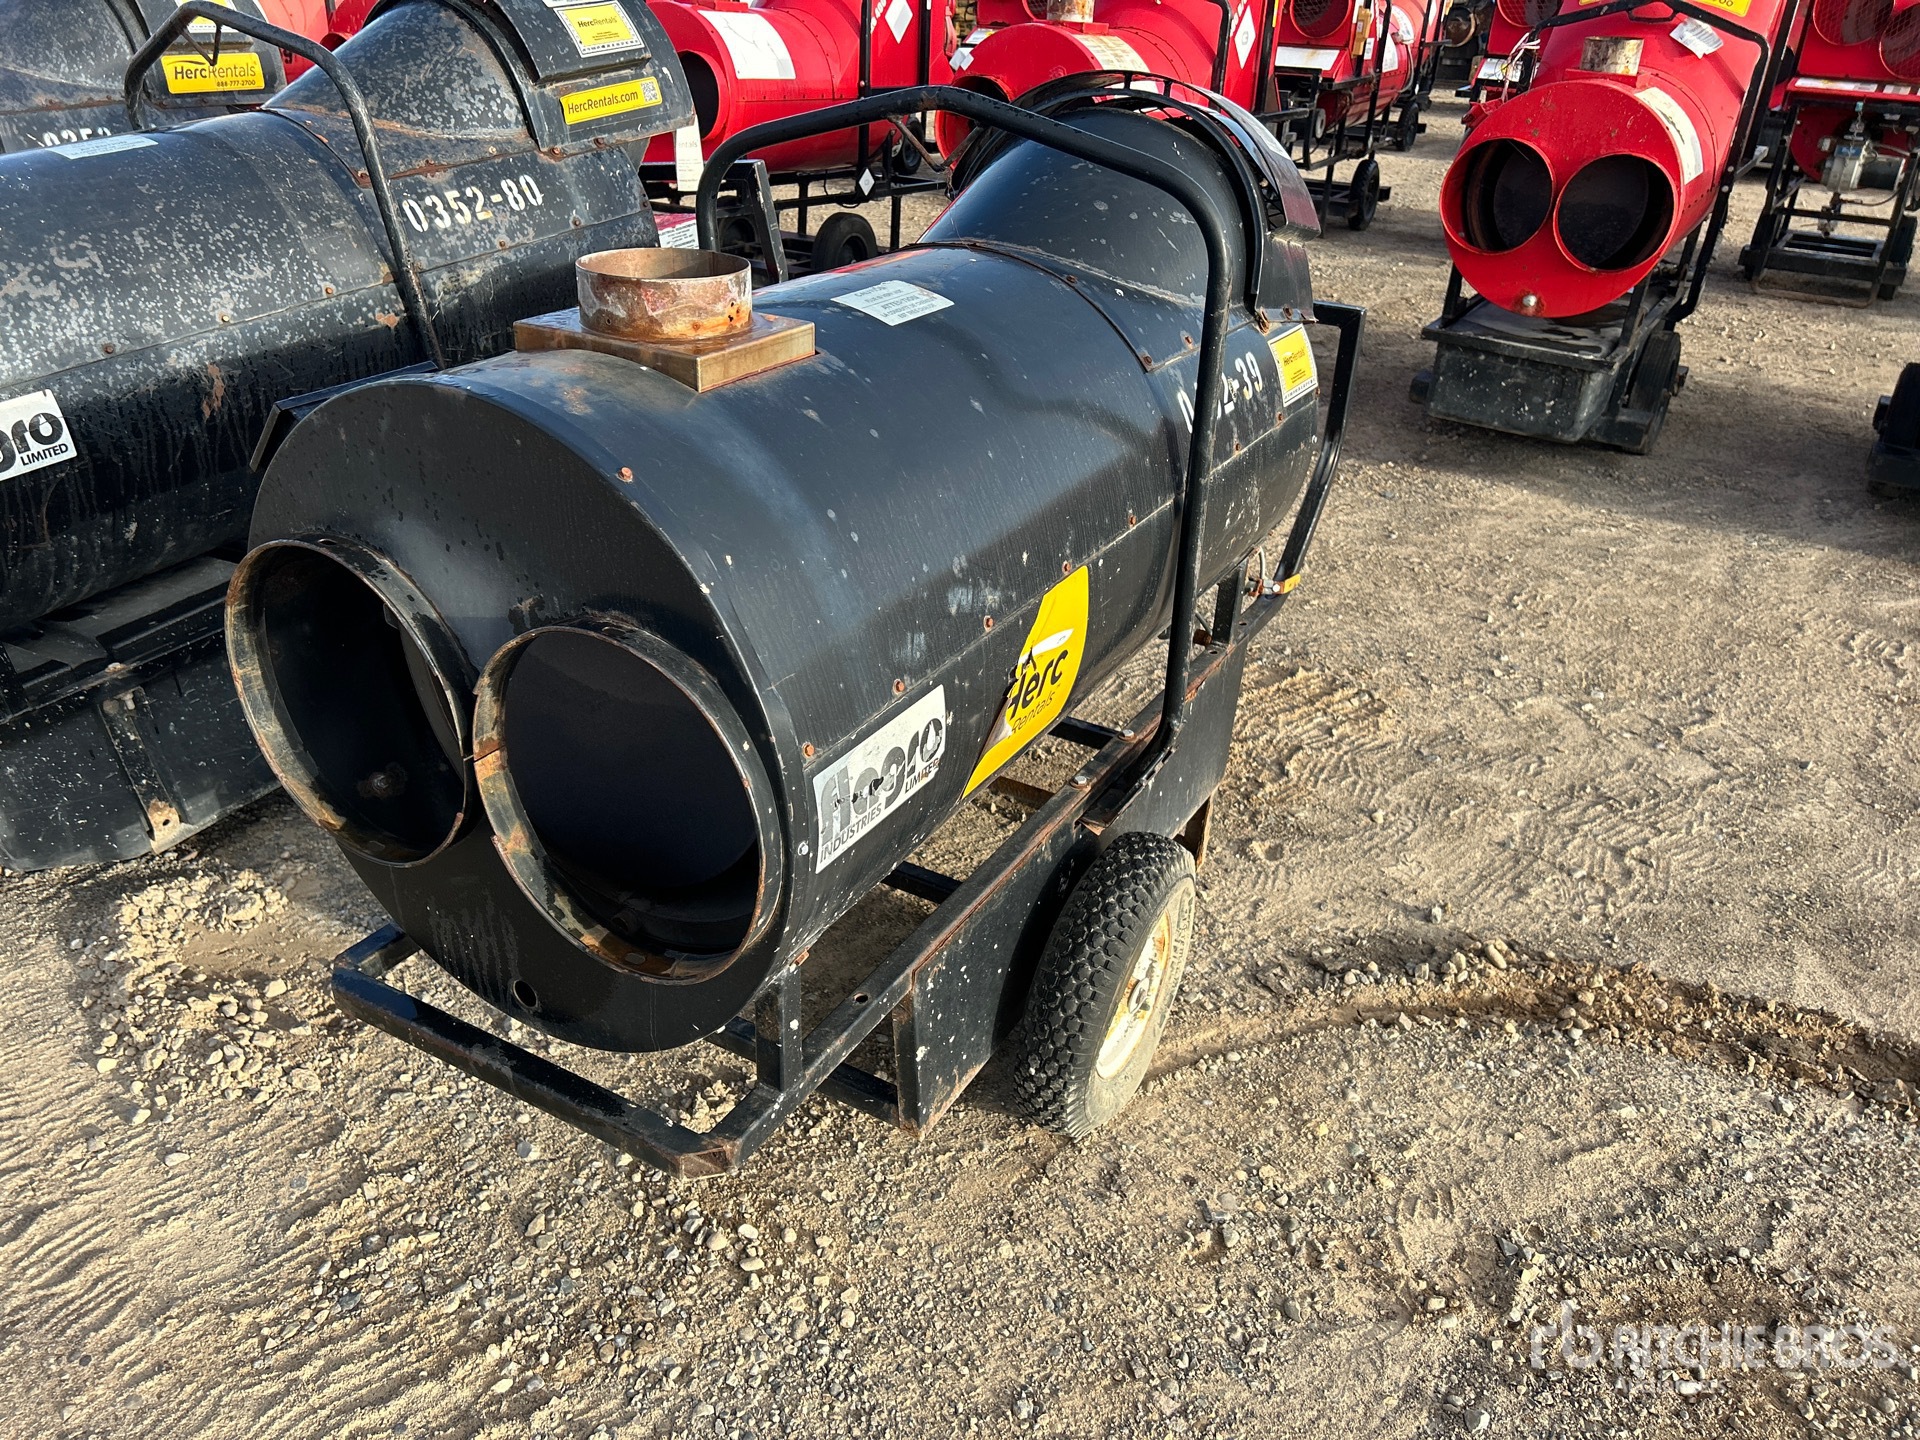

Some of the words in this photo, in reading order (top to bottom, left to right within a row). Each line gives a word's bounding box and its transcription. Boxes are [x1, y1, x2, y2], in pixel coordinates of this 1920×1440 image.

[567, 91, 639, 114] HercRentals.com
[402, 174, 543, 233] 0352-80
[20, 443, 69, 466] LIMITED
[821, 802, 882, 864] INDUSTRIES
